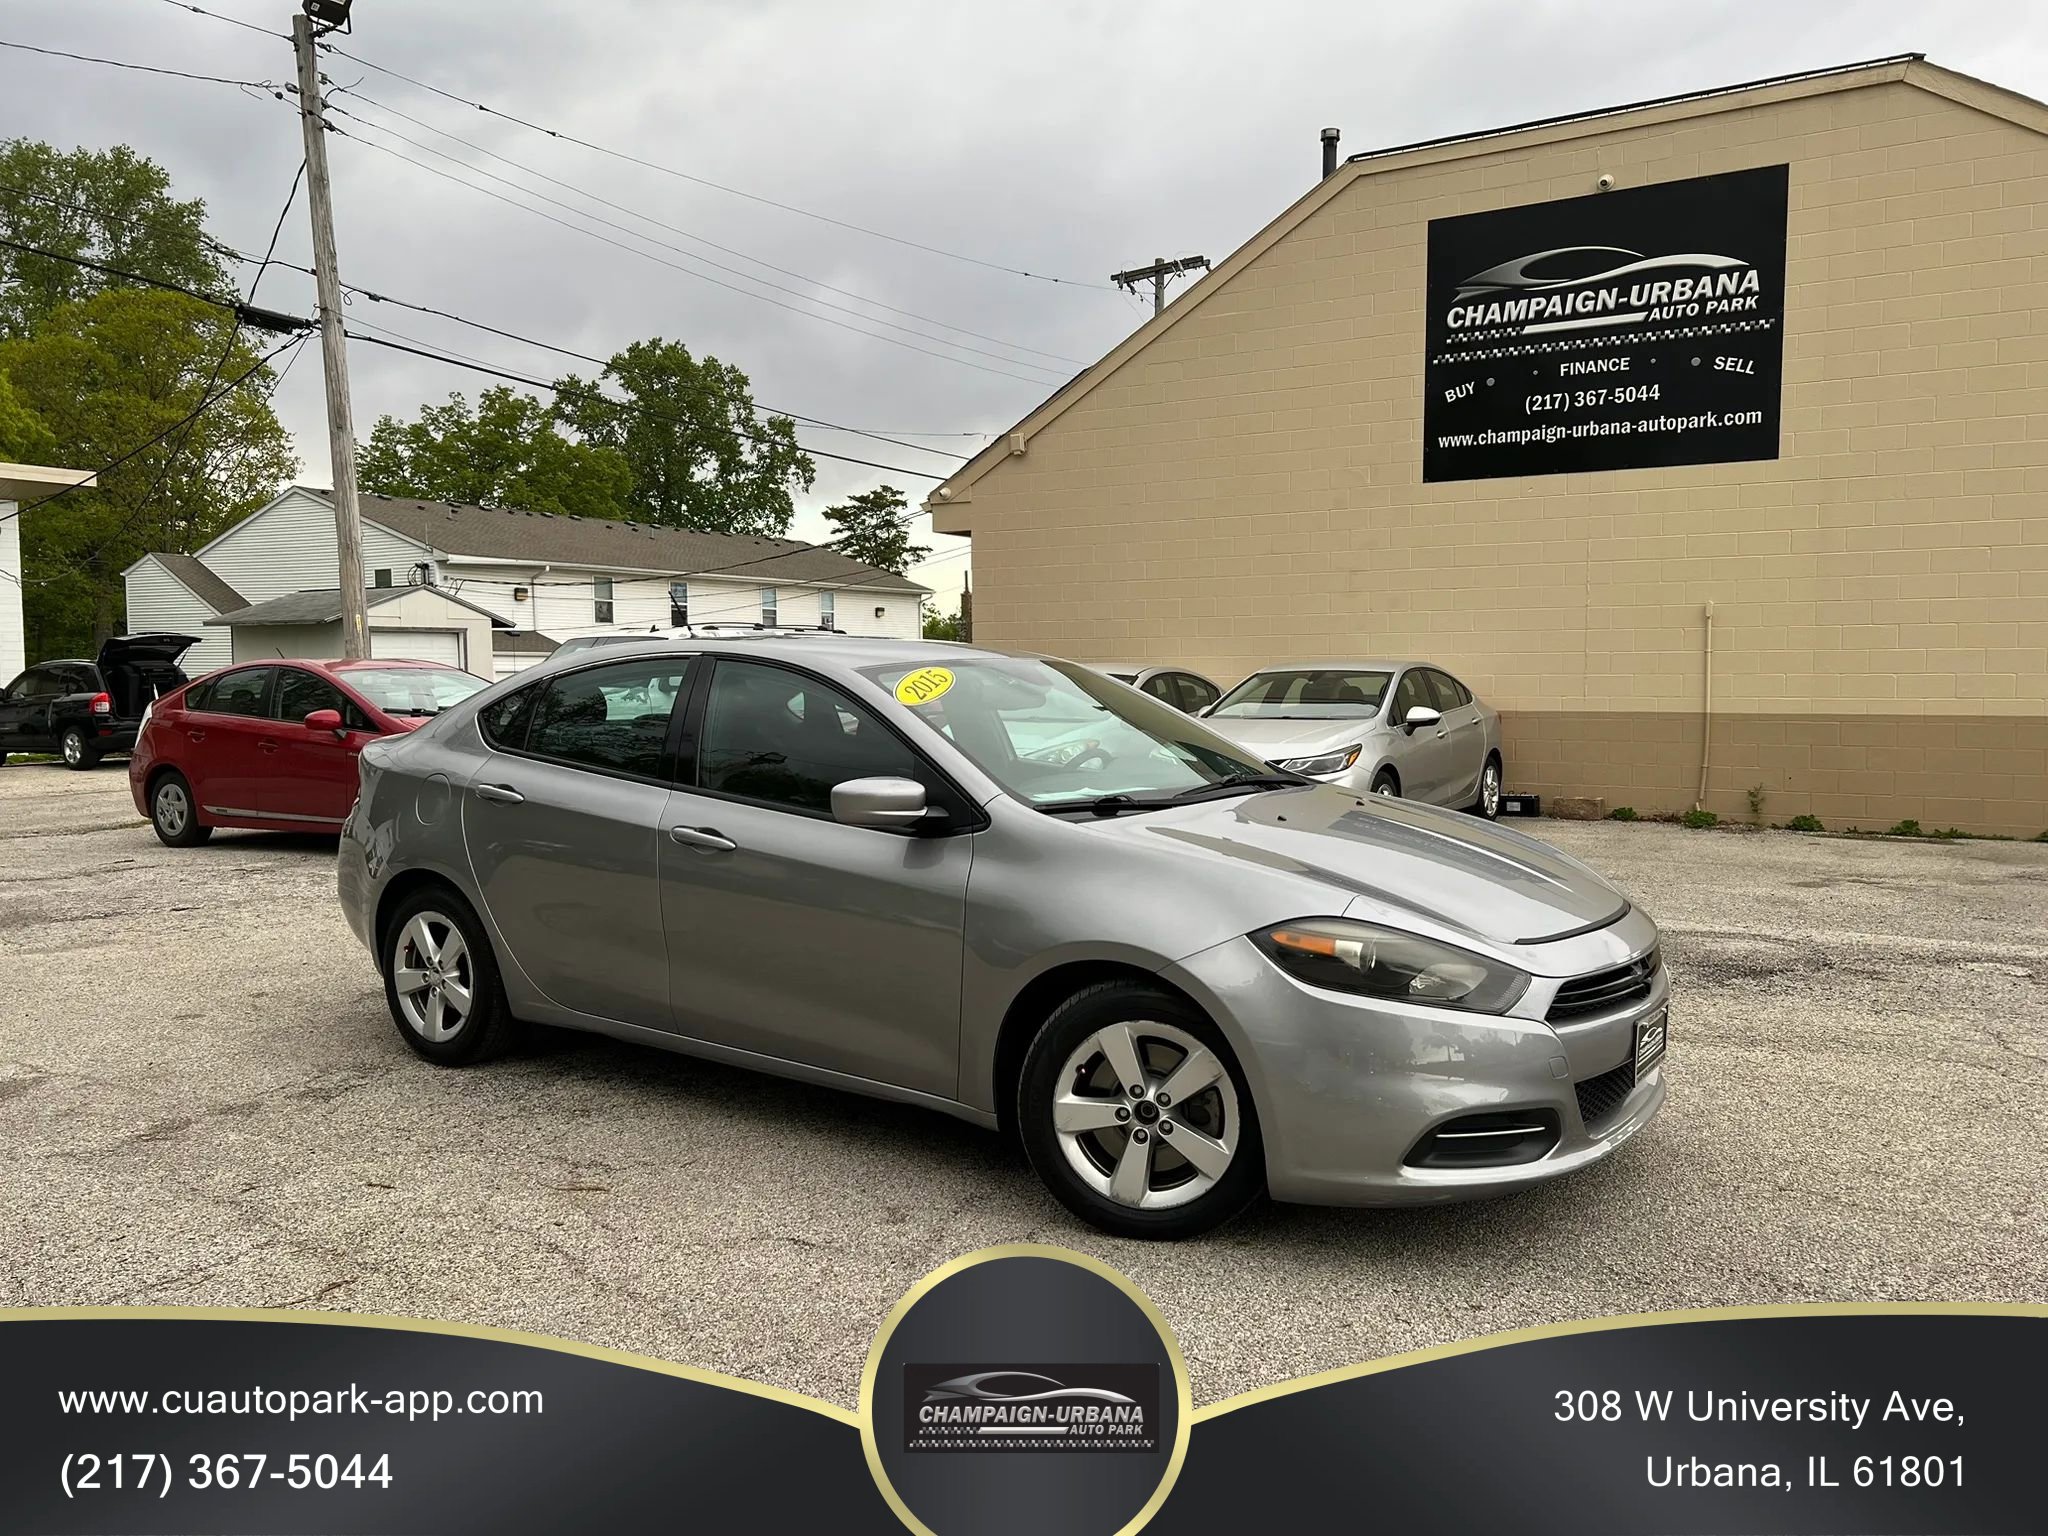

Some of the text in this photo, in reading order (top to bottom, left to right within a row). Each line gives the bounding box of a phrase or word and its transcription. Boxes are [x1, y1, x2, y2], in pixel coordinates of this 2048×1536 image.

[1446, 269, 1760, 329] CHAMPAIGN-URBANA
[1647, 295, 1759, 322] AUTO PARK
[1444, 356, 1756, 403] BUY FINANCE SELL
[1525, 383, 1661, 415] (217) 367-5044
[1437, 409, 1763, 449] www.champaign-urbana-autopark.com
[904, 669, 948, 701] 2015
